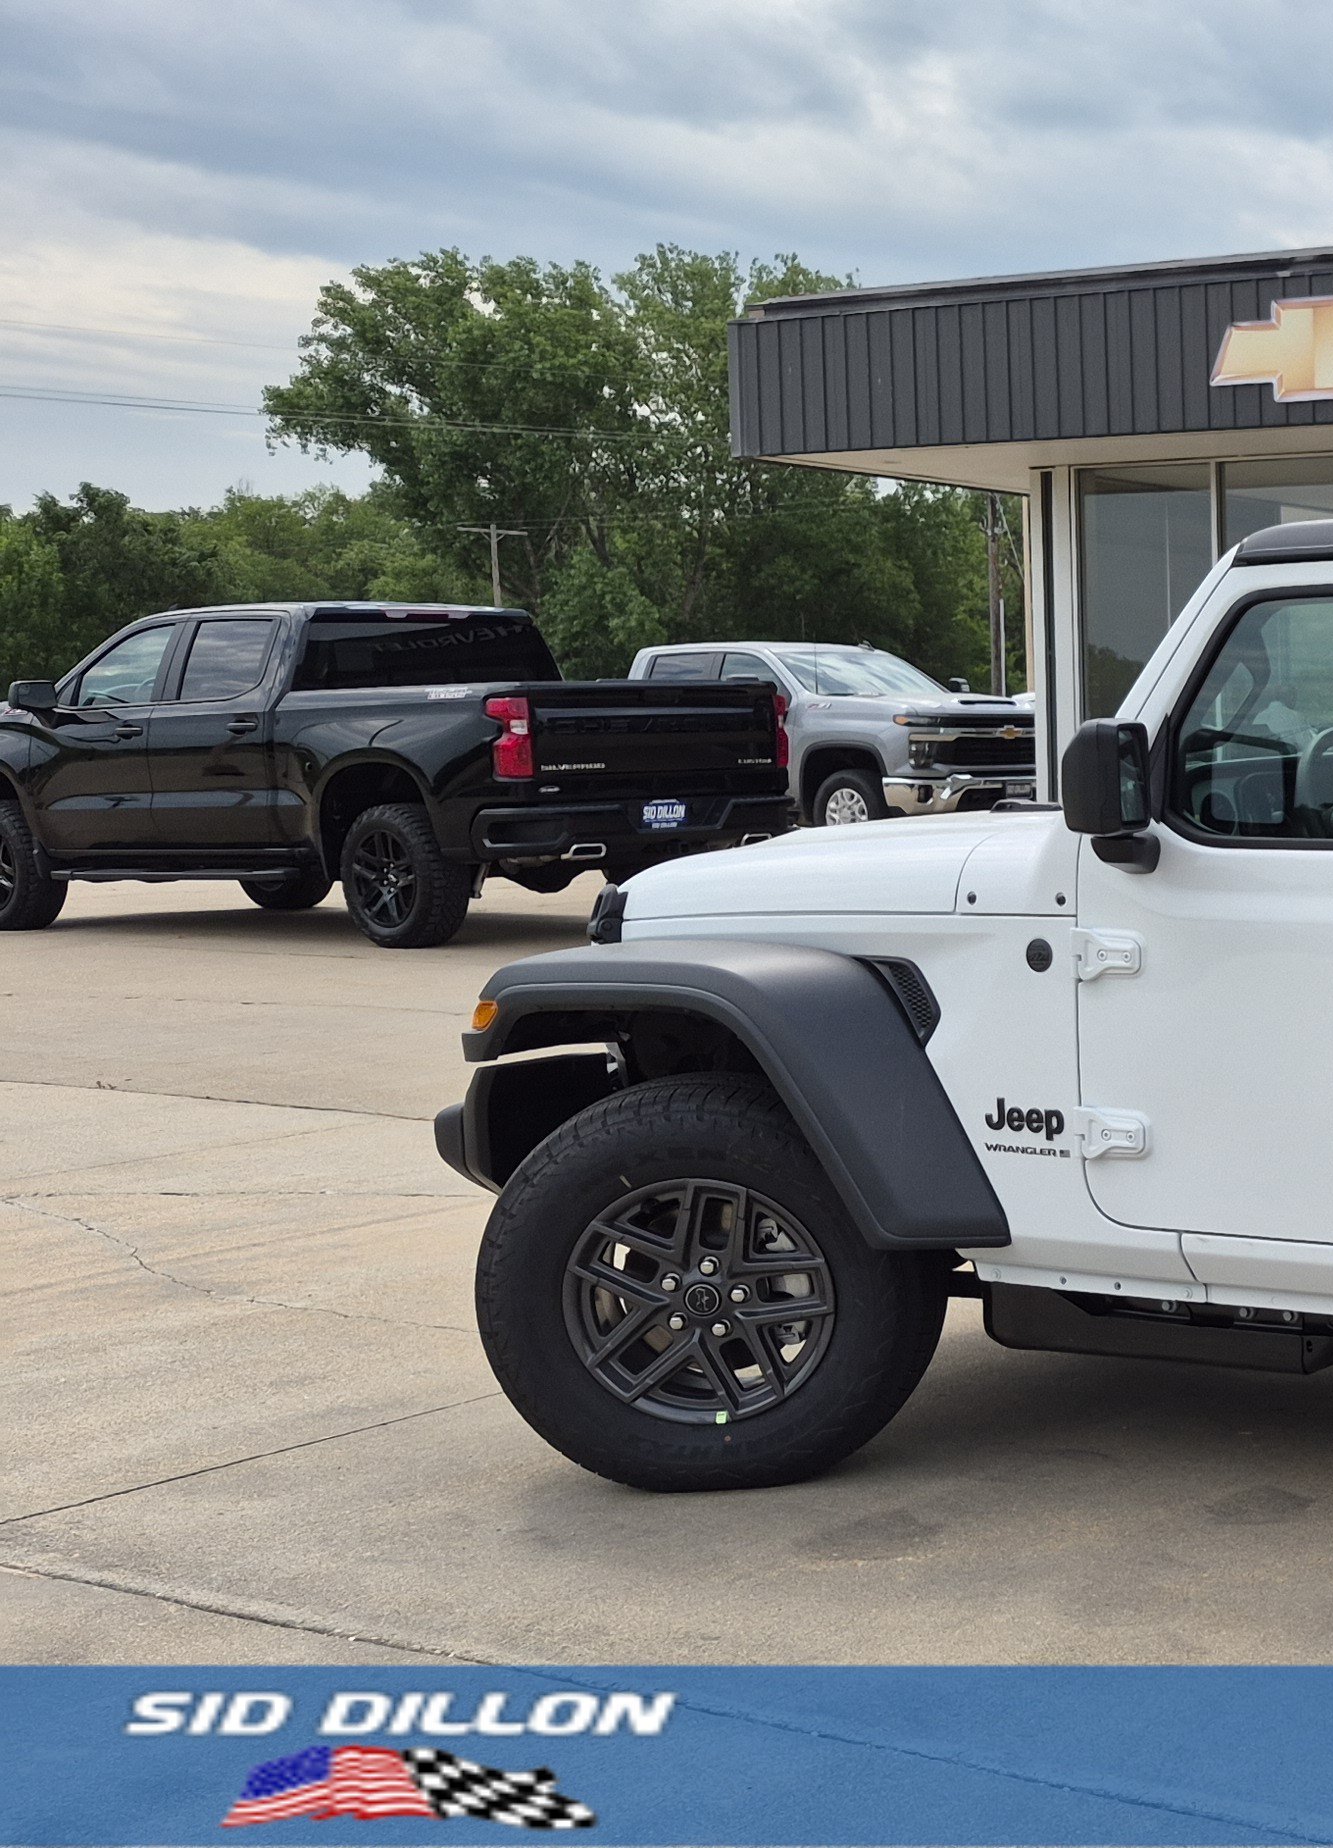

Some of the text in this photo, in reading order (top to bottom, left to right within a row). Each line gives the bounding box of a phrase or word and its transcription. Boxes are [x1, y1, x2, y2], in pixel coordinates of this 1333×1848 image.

[643, 804, 686, 820] SID DILLON
[985, 1097, 1065, 1141] Jeep
[984, 1142, 1058, 1158] WRANGLER
